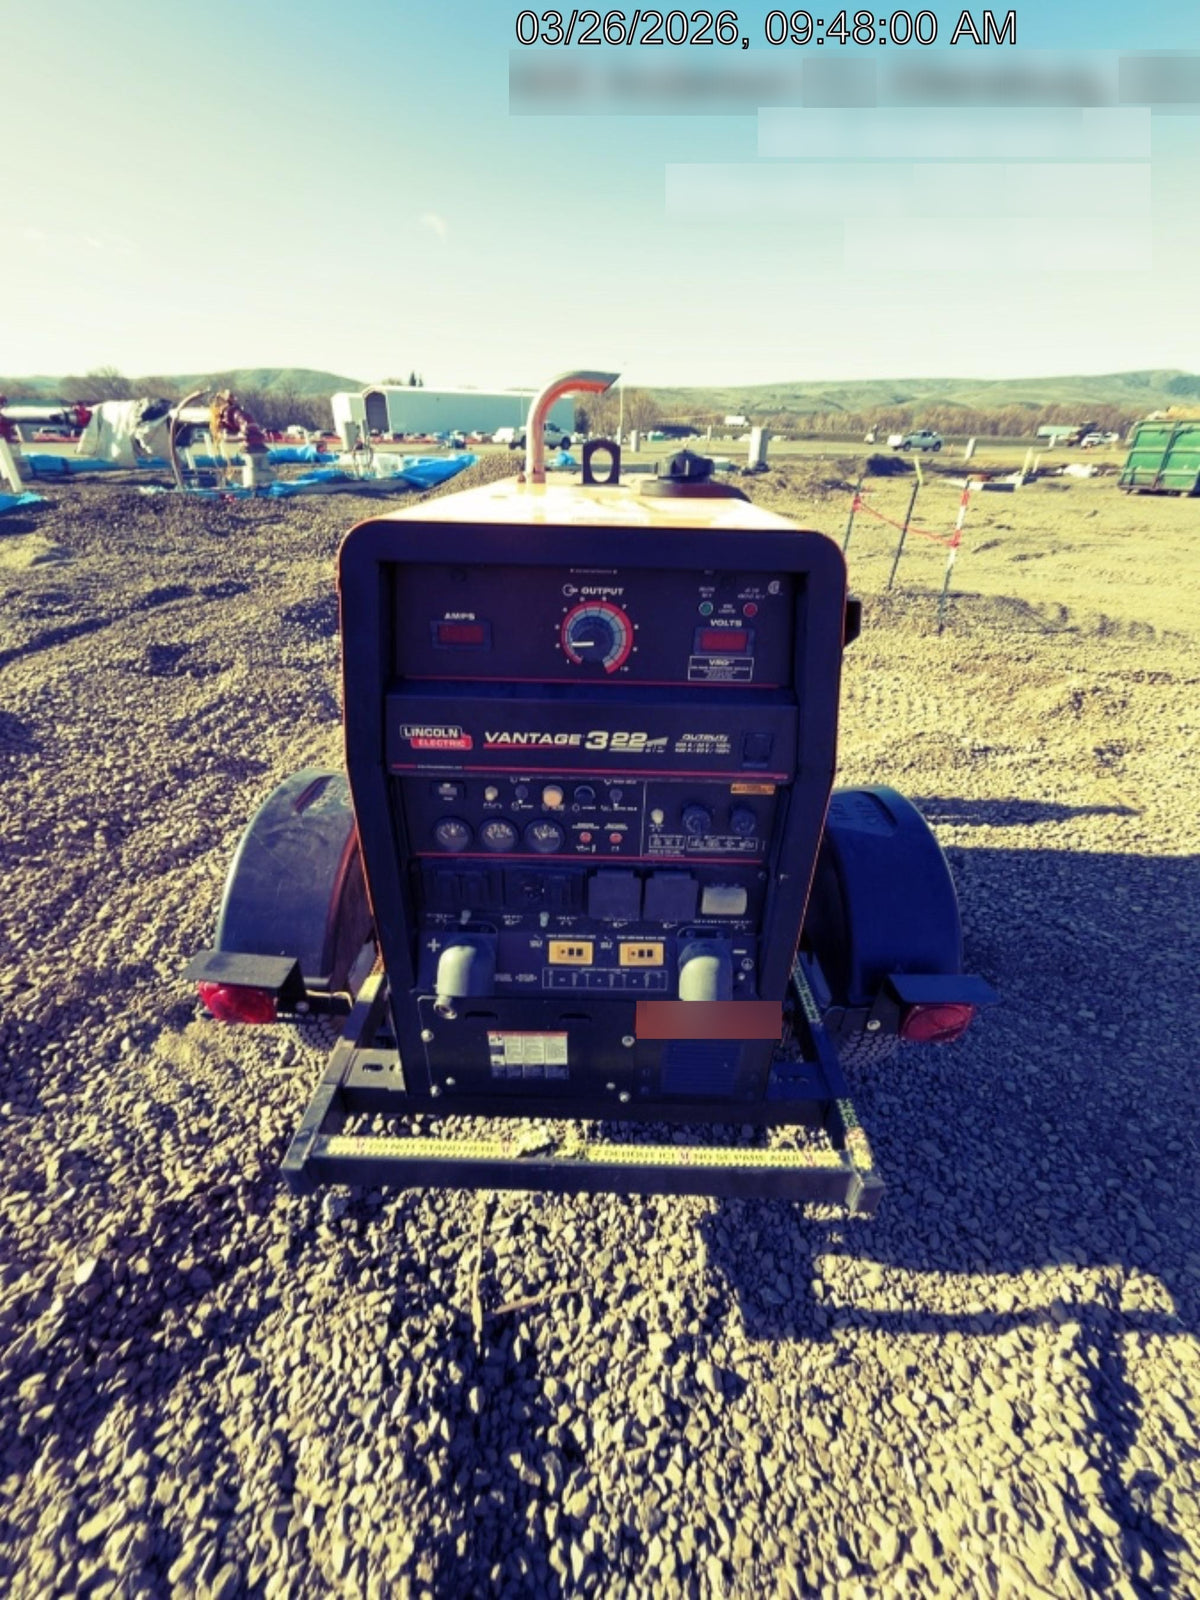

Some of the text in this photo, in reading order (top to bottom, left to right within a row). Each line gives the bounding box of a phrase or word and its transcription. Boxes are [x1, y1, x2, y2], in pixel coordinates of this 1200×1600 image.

[581, 587, 624, 595] OUTPUT
[444, 612, 475, 620] AMPS
[710, 619, 742, 627] VOLTS
[404, 727, 458, 738] LINCOLN
[418, 738, 466, 748] ELECTRIC
[485, 732, 582, 746] VANTAGE
[585, 730, 648, 750] 322
